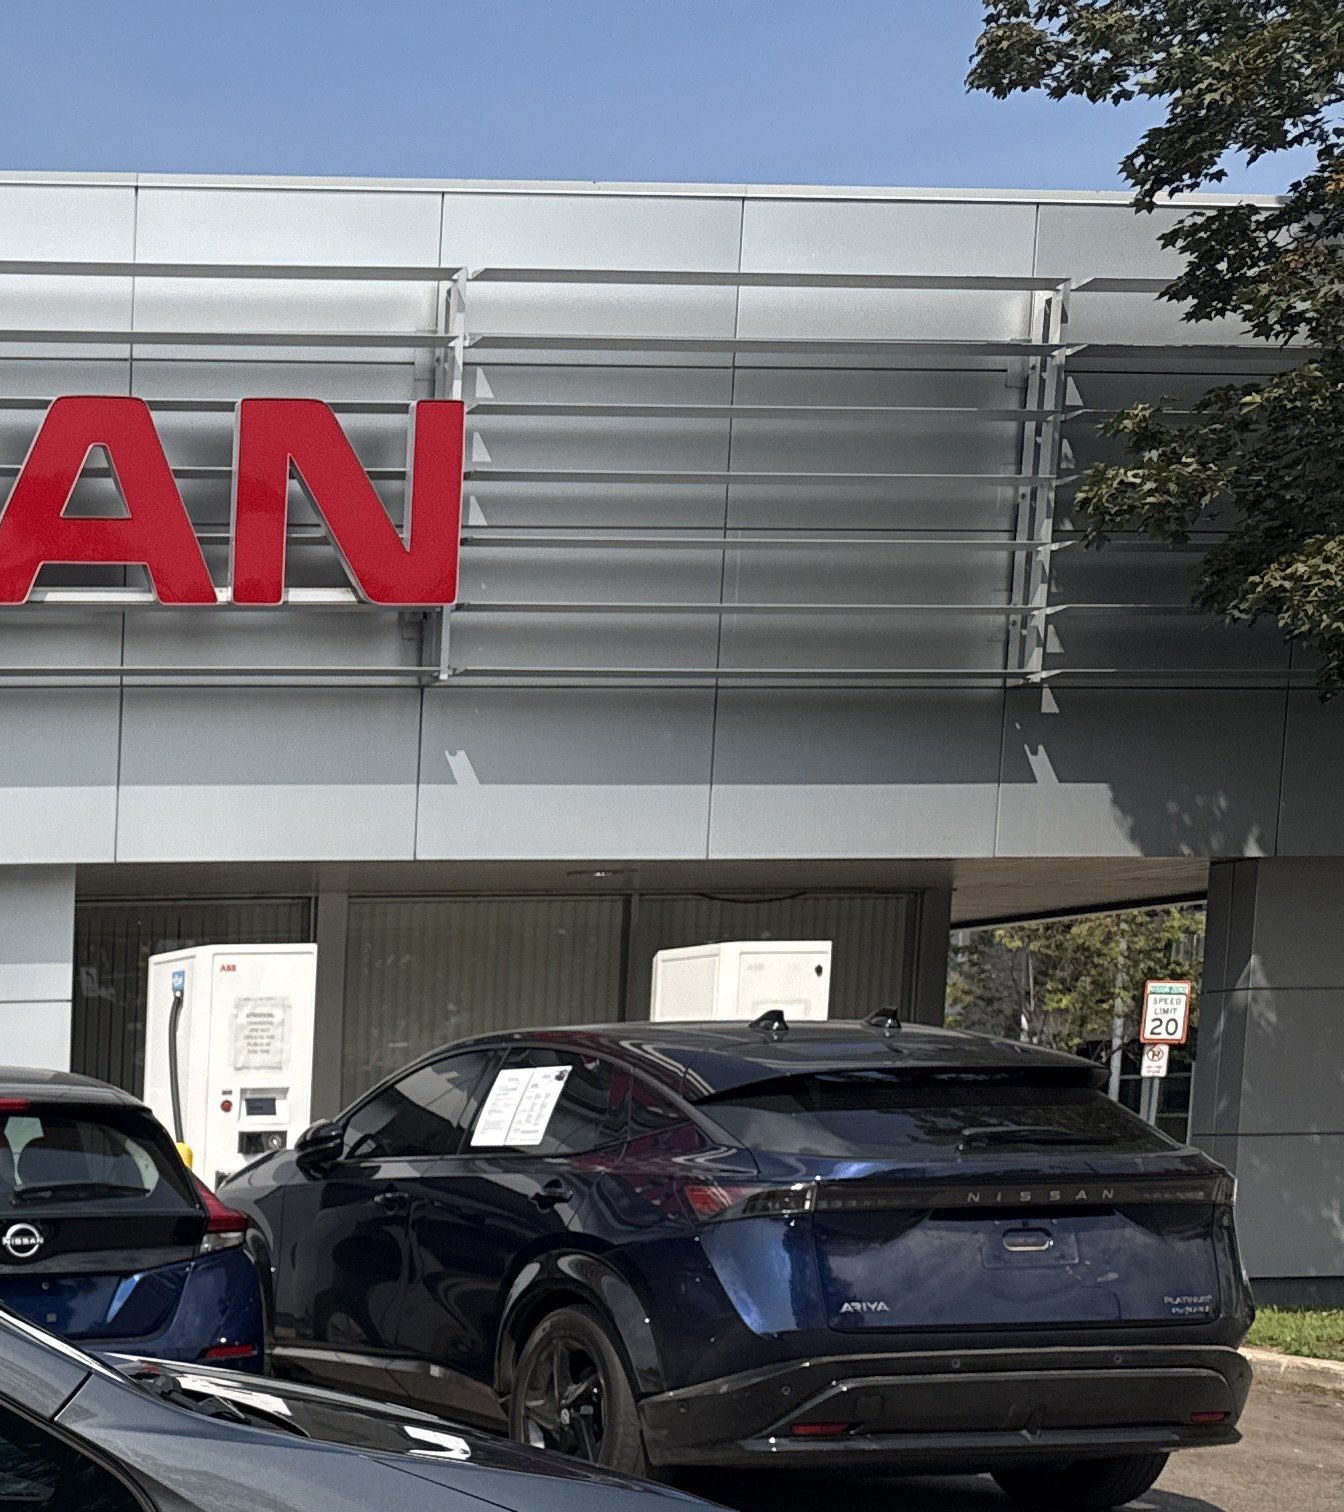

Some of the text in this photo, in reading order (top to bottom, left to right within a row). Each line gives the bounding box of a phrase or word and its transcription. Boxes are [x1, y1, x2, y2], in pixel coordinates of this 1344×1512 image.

[219, 964, 236, 972] ABB
[1153, 997, 1182, 1006] SPEED
[1154, 1007, 1178, 1016] LIMIT
[1149, 1017, 1179, 1036] 20
[967, 1189, 1115, 1203] NISSAN
[2, 1236, 44, 1246] NISSAN
[840, 1301, 891, 1314] ARIYA
